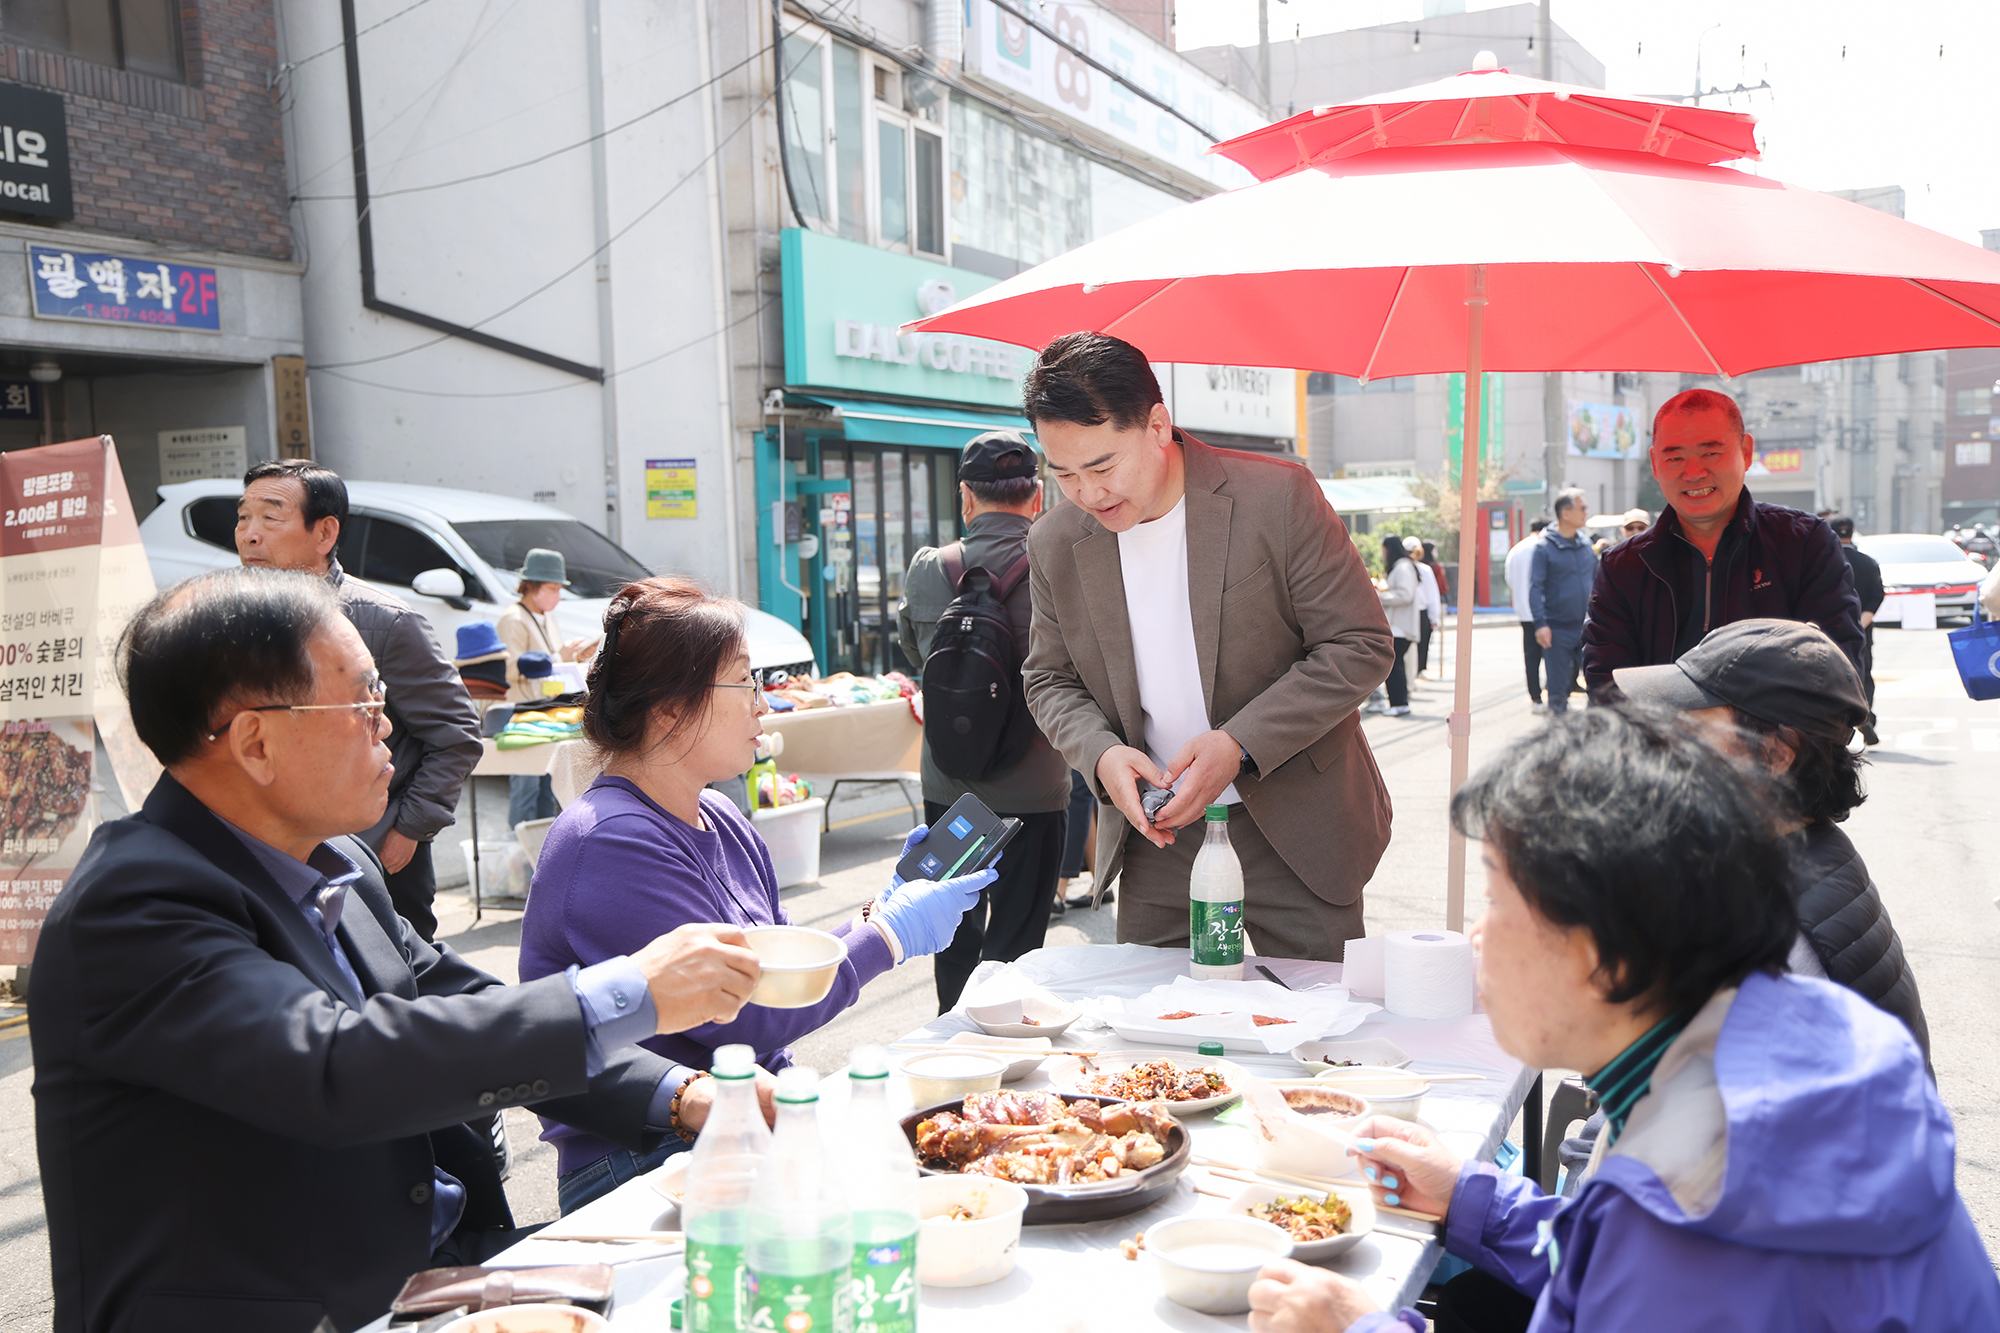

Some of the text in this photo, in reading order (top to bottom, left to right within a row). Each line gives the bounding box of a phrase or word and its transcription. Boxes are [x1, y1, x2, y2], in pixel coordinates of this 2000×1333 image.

[179, 270, 216, 316] 2F
[834, 318, 1024, 382] DAILY COFFEE
[0, 384, 32, 415] 회
[23, 471, 74, 498] 방문포장
[4, 496, 88, 527] 2,000원 할인
[2, 606, 75, 632] 전설의 바베큐
[37, 637, 83, 665] 숯불의
[51, 672, 83, 697] 치킨
[1208, 916, 1244, 941] 장수
